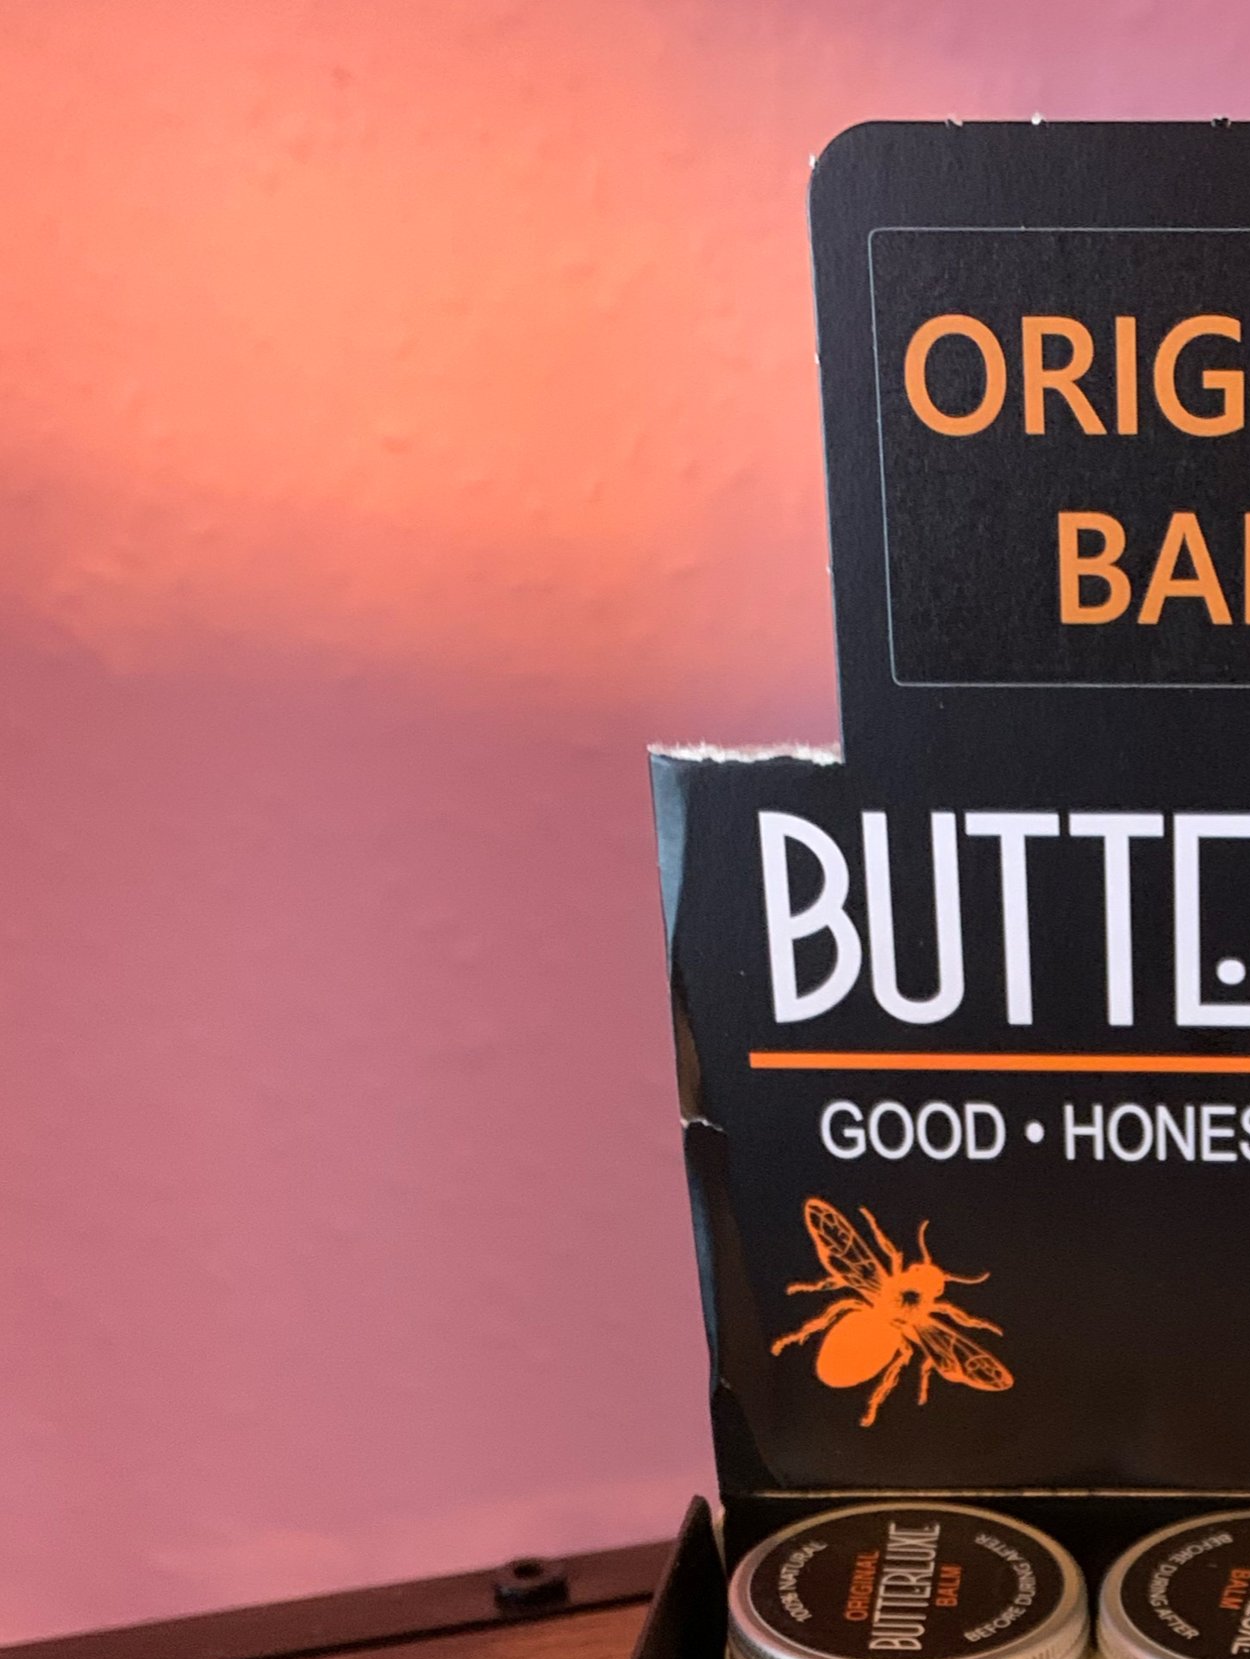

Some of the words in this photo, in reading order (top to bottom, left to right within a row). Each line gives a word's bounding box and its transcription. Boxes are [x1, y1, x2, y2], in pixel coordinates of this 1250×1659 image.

[819, 1101, 1007, 1162] GOOD
[845, 1552, 879, 1621] ORIGINAL
[869, 1522, 940, 1649] BUTTERLUXE
[936, 1564, 961, 1607] BALM
